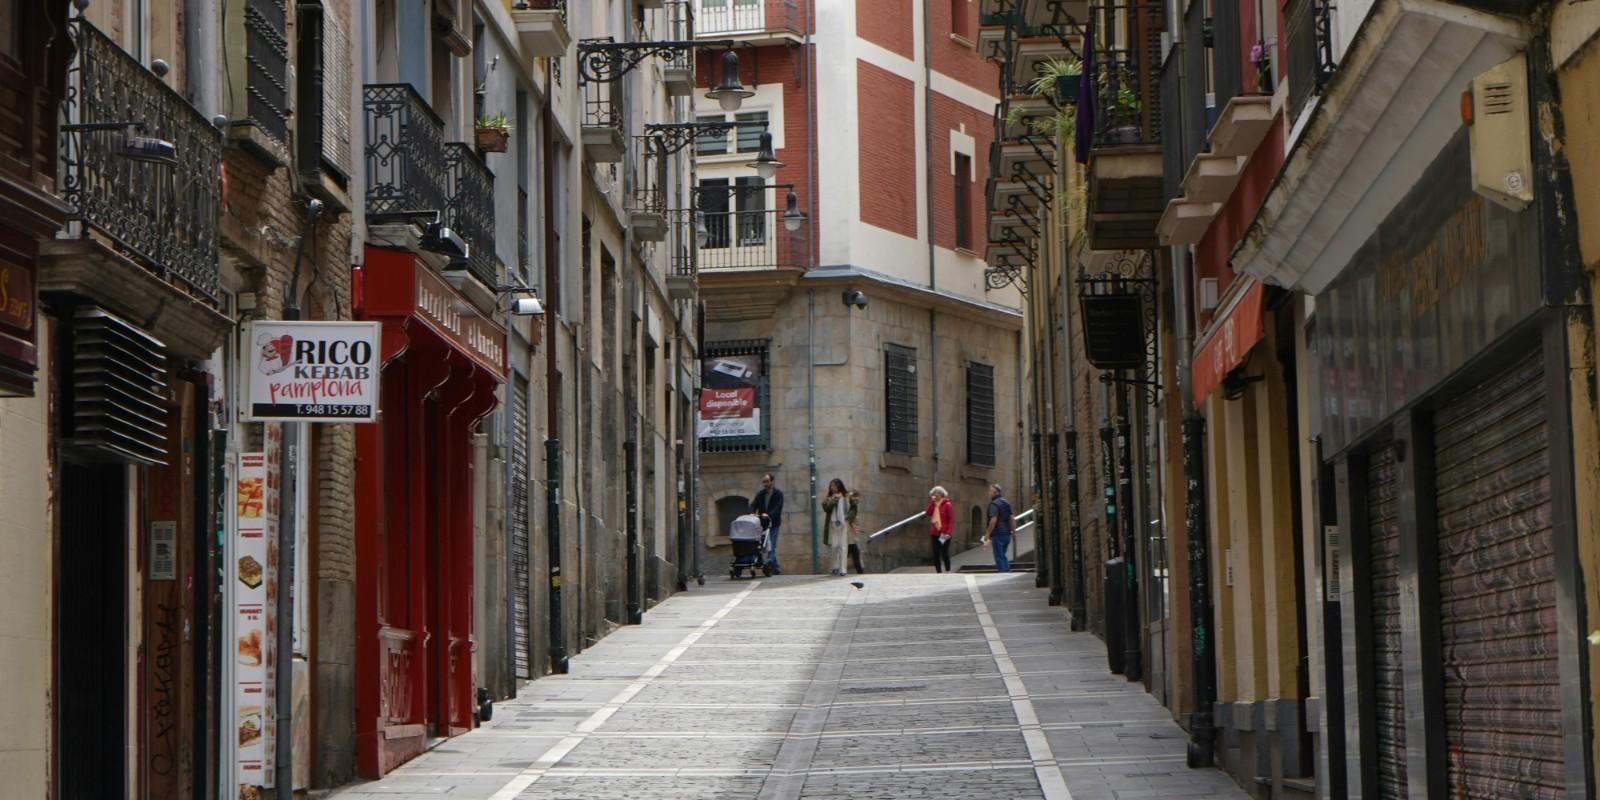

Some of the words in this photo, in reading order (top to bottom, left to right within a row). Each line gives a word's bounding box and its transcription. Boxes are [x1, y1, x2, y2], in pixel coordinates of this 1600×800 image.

[295, 340, 372, 365] RICO
[294, 366, 370, 380] KEBAB
[268, 374, 363, 408] pamplona
[715, 390, 738, 398] Local
[706, 398, 748, 408] disponible
[296, 404, 304, 414] T.
[306, 404, 324, 415] 948
[327, 405, 339, 415] 15
[341, 405, 353, 415] 57
[355, 405, 369, 415] 88
